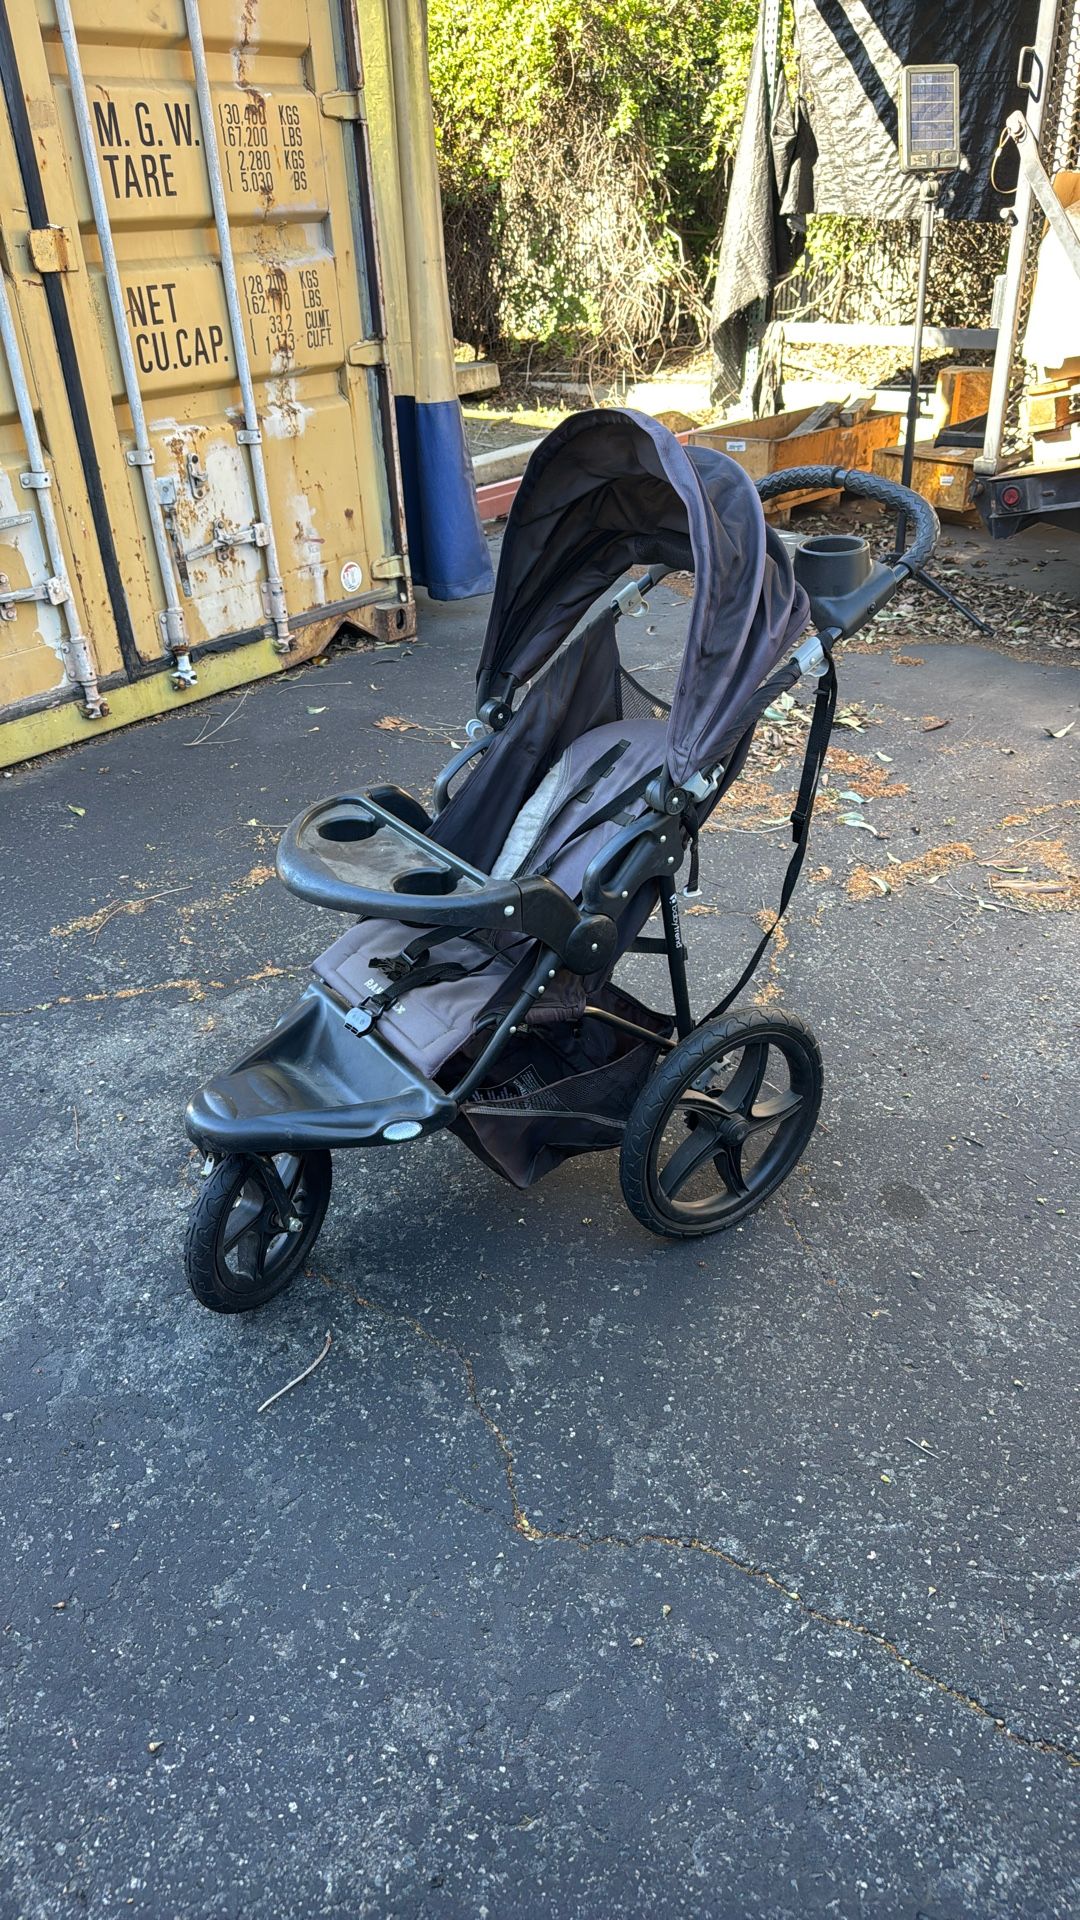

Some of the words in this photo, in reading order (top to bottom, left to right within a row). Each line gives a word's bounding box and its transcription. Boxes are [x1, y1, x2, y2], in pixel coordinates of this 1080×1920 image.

[278, 104, 300, 126] KGS
[281, 126, 303, 147] LBS
[284, 150, 305, 170] KGS
[103, 154, 177, 199] TARE
[289, 171, 307, 191] BS
[298, 269, 319, 290] KGS
[126, 283, 177, 328] NET
[136, 325, 229, 374] CU.CAP.
[363, 977, 384, 995] RAN
